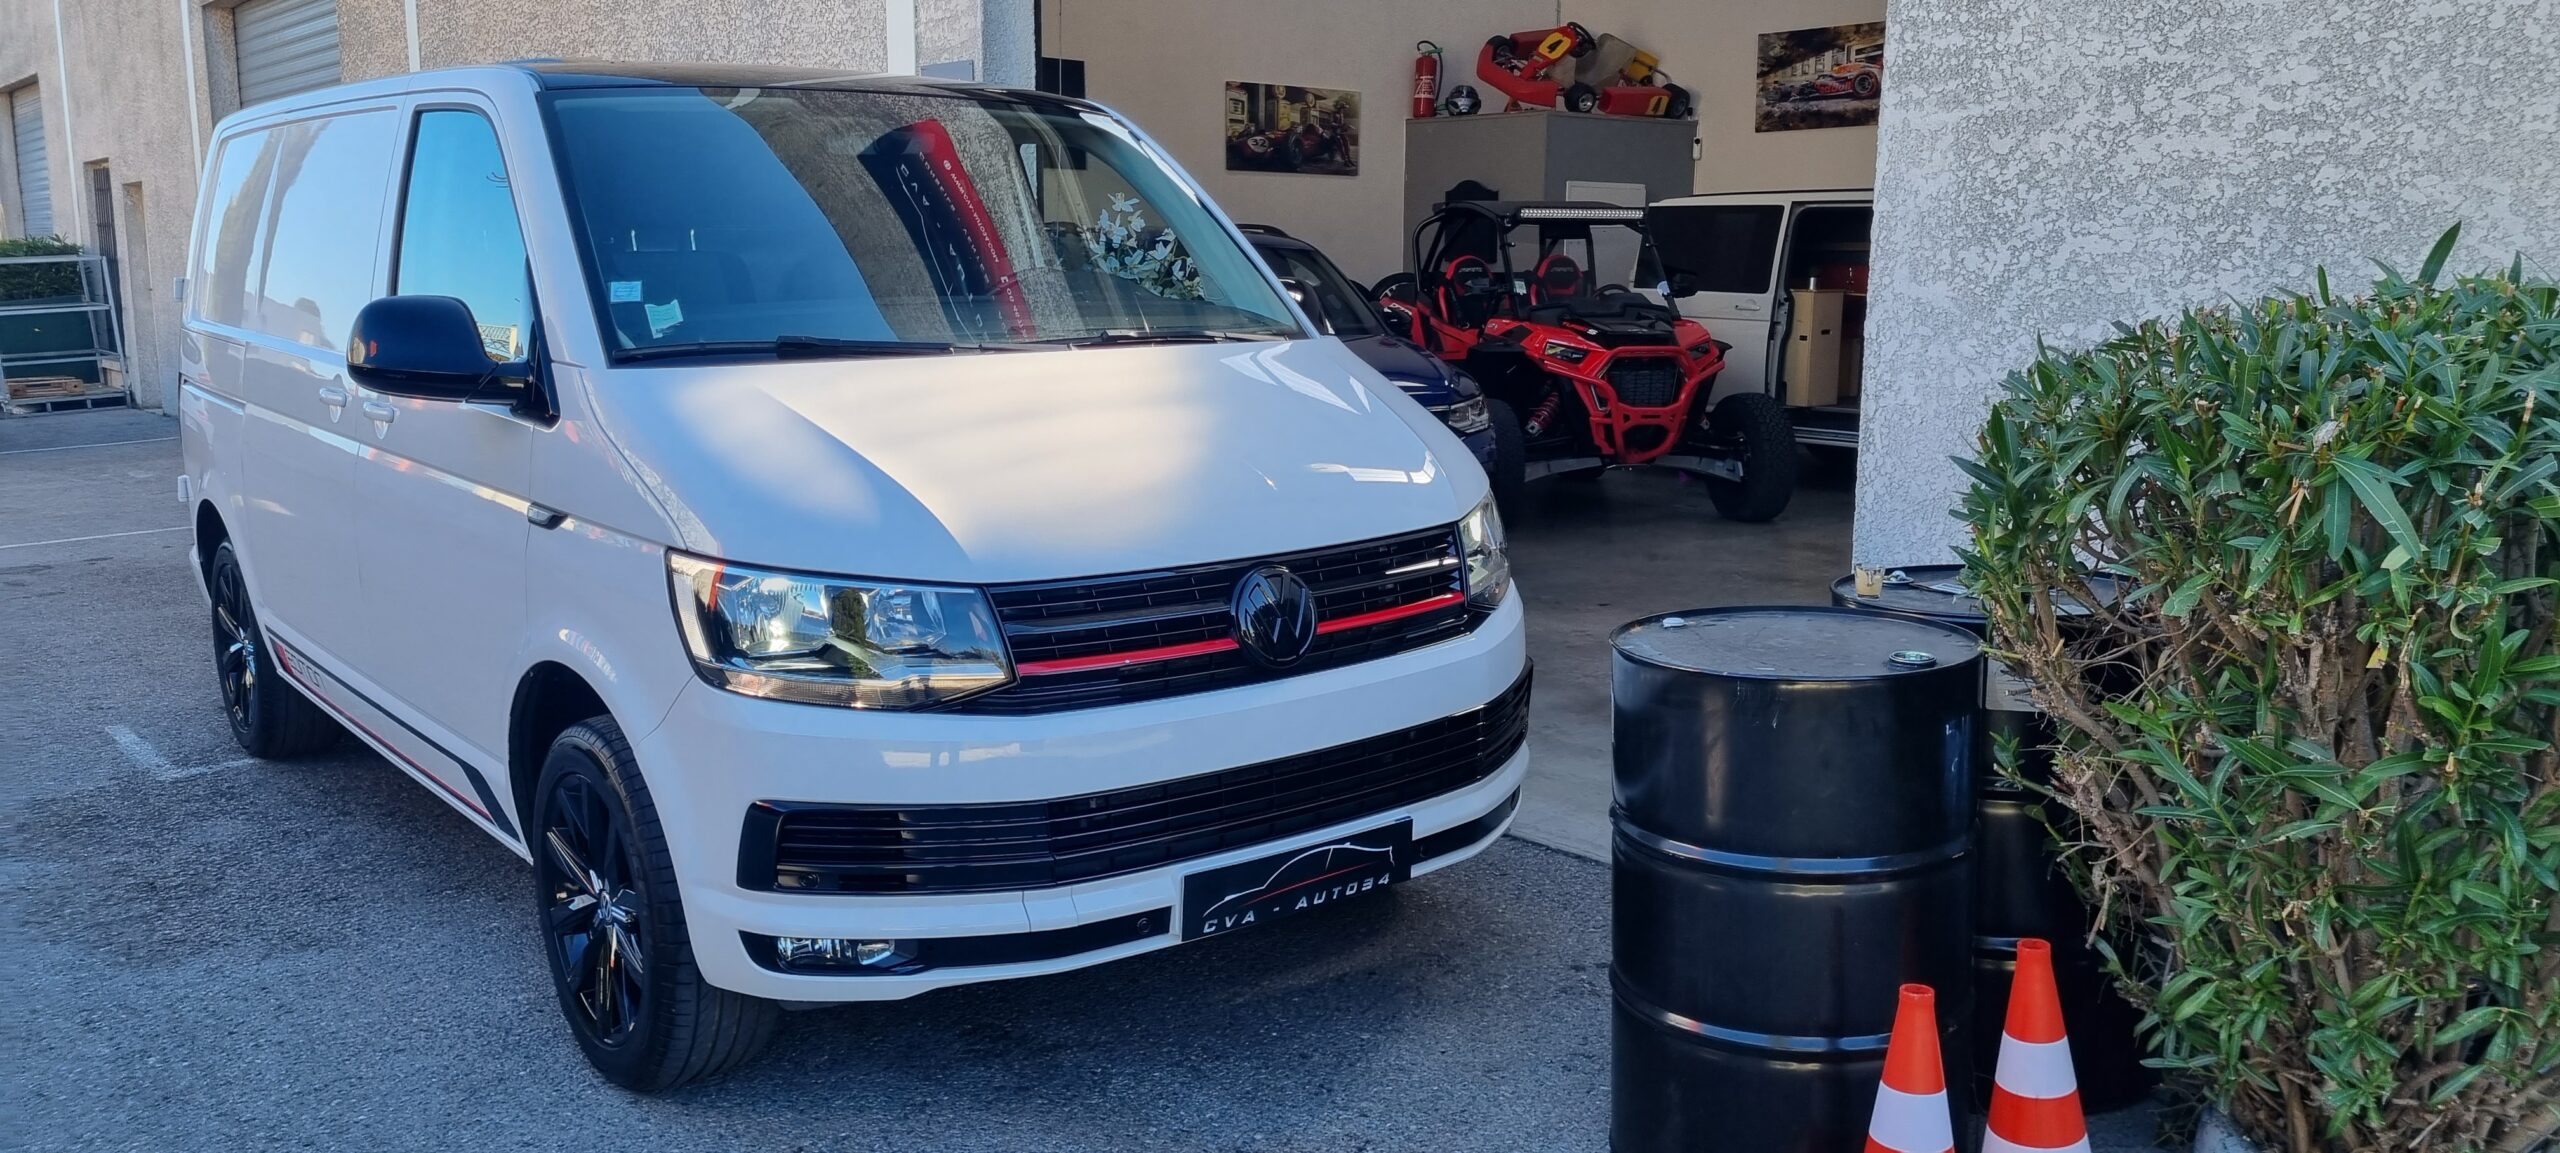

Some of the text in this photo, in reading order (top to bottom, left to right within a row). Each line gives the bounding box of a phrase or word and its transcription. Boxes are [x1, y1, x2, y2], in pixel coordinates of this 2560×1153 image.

[1251, 138, 1268, 149] 32
[1202, 910, 1255, 934] CVA
[1294, 872, 1391, 911] AUTO34
